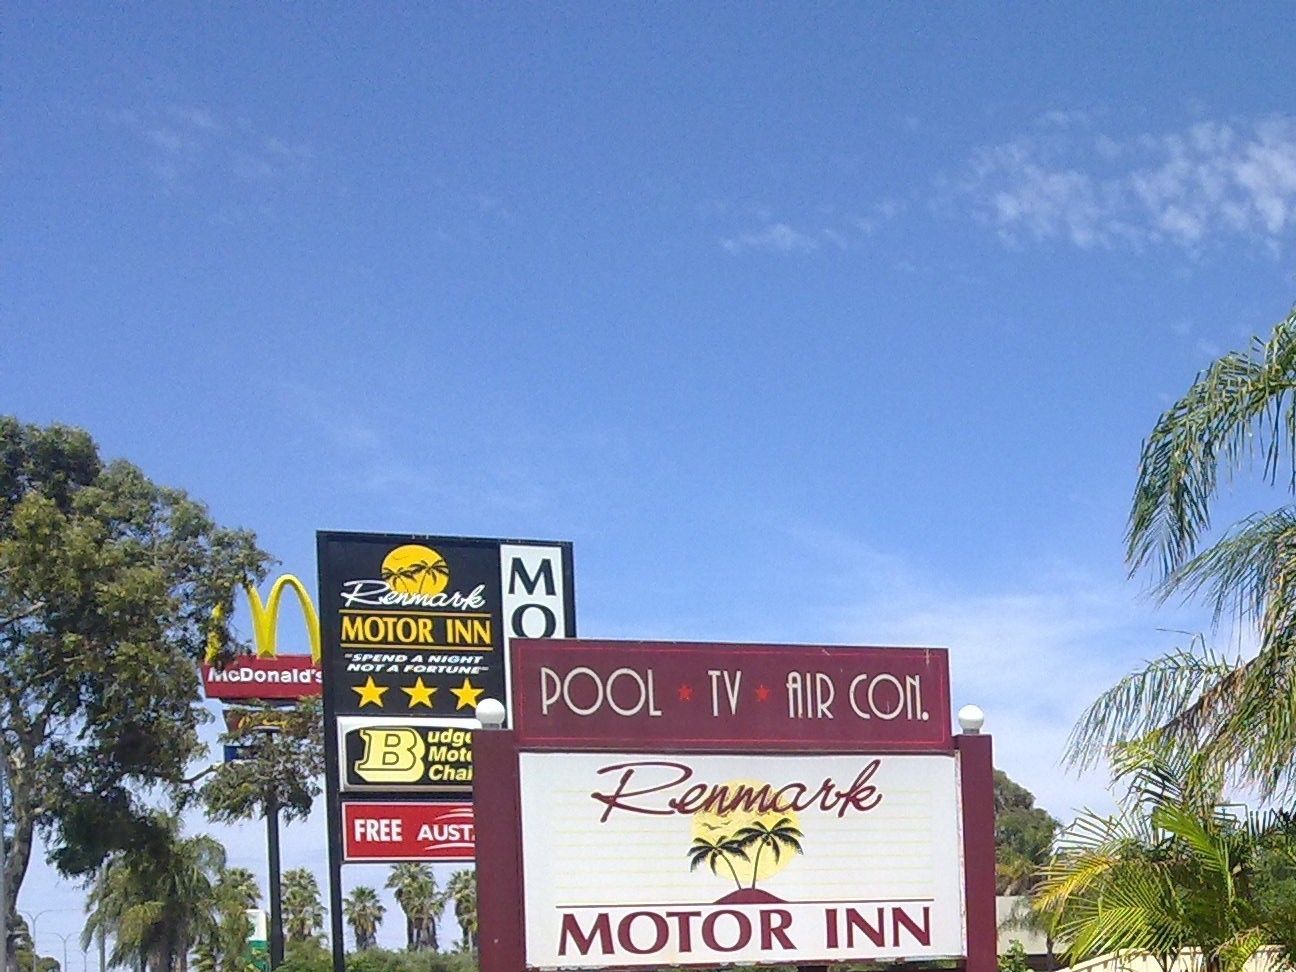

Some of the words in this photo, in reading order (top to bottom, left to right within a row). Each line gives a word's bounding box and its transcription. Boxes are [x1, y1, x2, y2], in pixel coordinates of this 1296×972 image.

[340, 579, 486, 610] Renmark
[341, 615, 435, 643] MOTOR
[446, 618, 491, 644] INN
[347, 663, 385, 672] NOT
[387, 664, 399, 673] A
[411, 654, 424, 663] A
[427, 655, 483, 664] NIGHT
[541, 667, 662, 717] POOL
[708, 670, 742, 717] TV
[786, 671, 835, 720] AIR
[849, 673, 930, 721] CON.
[591, 759, 883, 823] Renmark
[354, 819, 403, 842] FREE
[416, 824, 475, 841] AUST
[557, 909, 798, 957] MOTOR
[825, 906, 932, 949] INN
